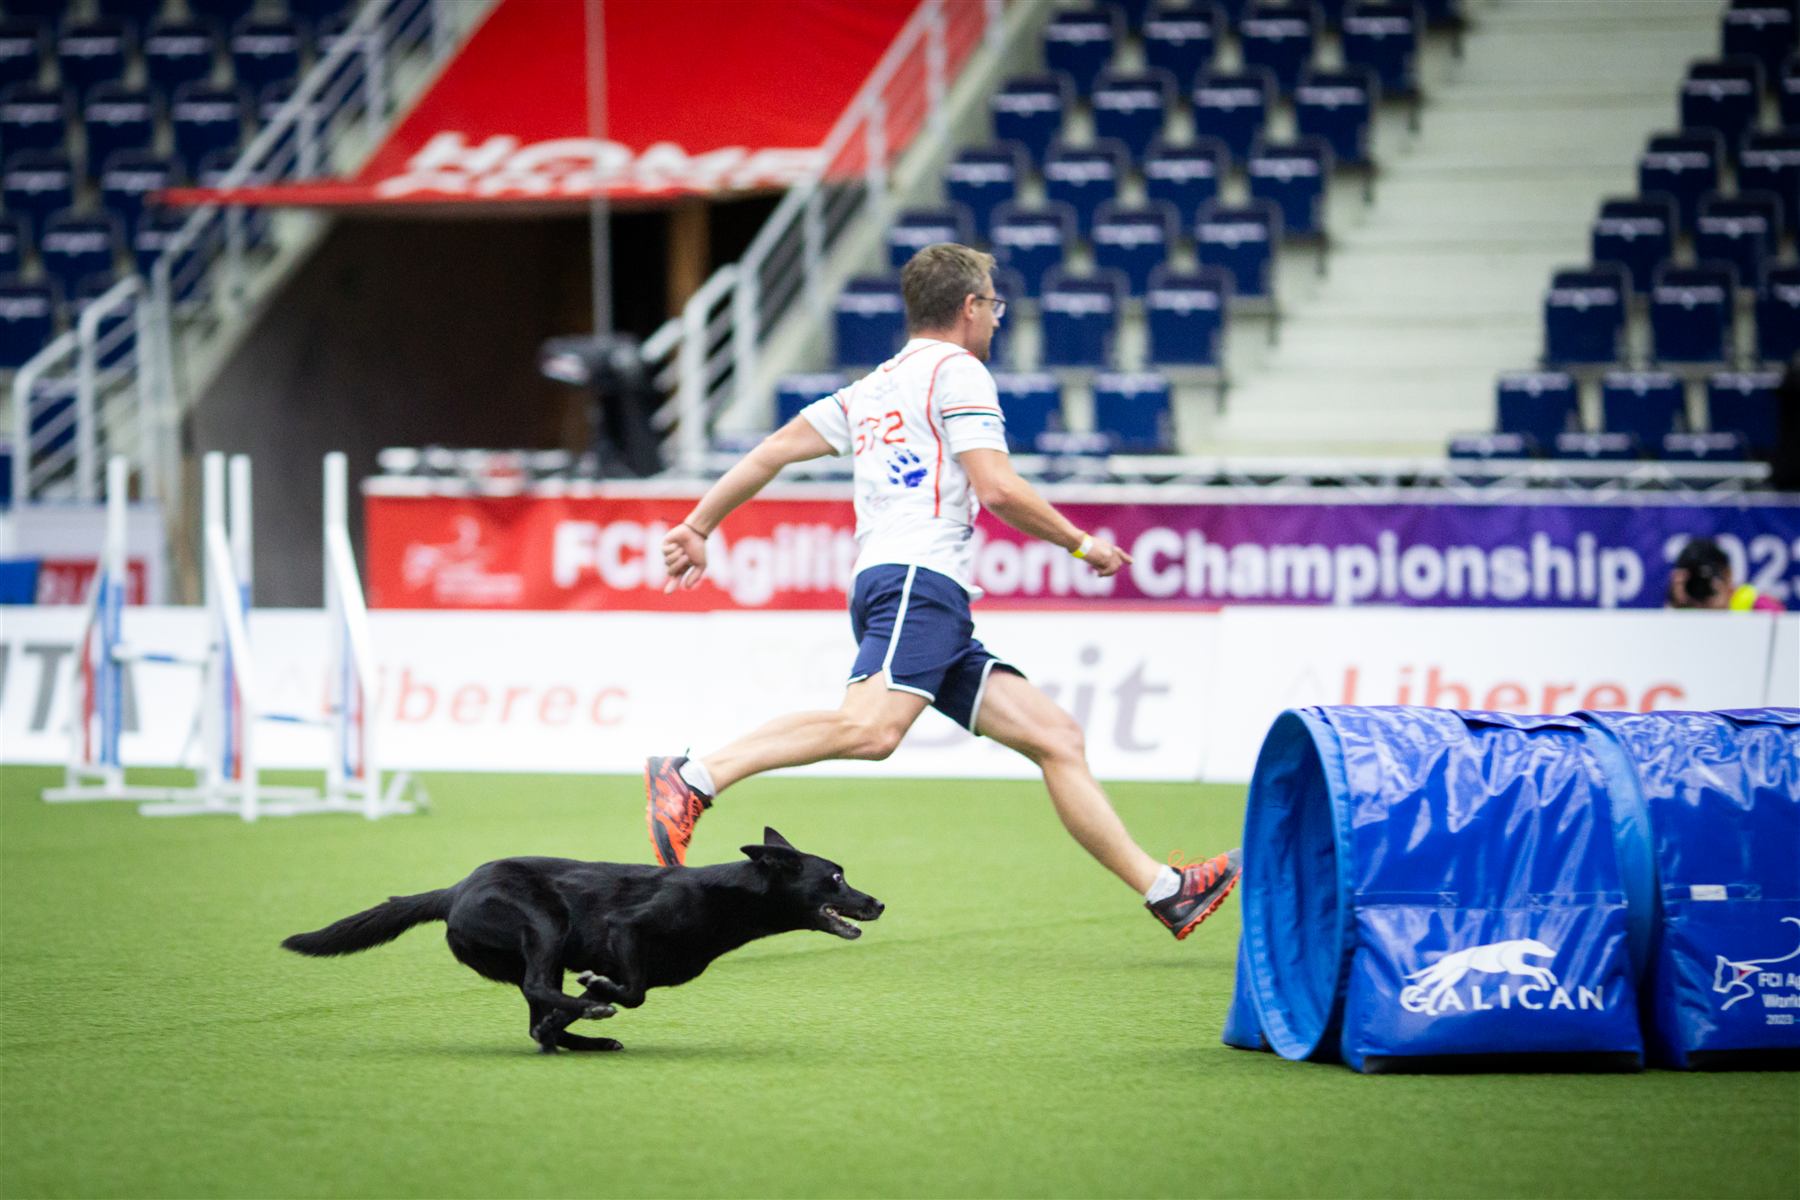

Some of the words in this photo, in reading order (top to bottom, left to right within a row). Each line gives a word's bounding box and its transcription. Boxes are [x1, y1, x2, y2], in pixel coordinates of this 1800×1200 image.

[682, 522, 855, 608] Agilit
[975, 526, 1117, 597] orld
[1129, 527, 1645, 608] Championship
